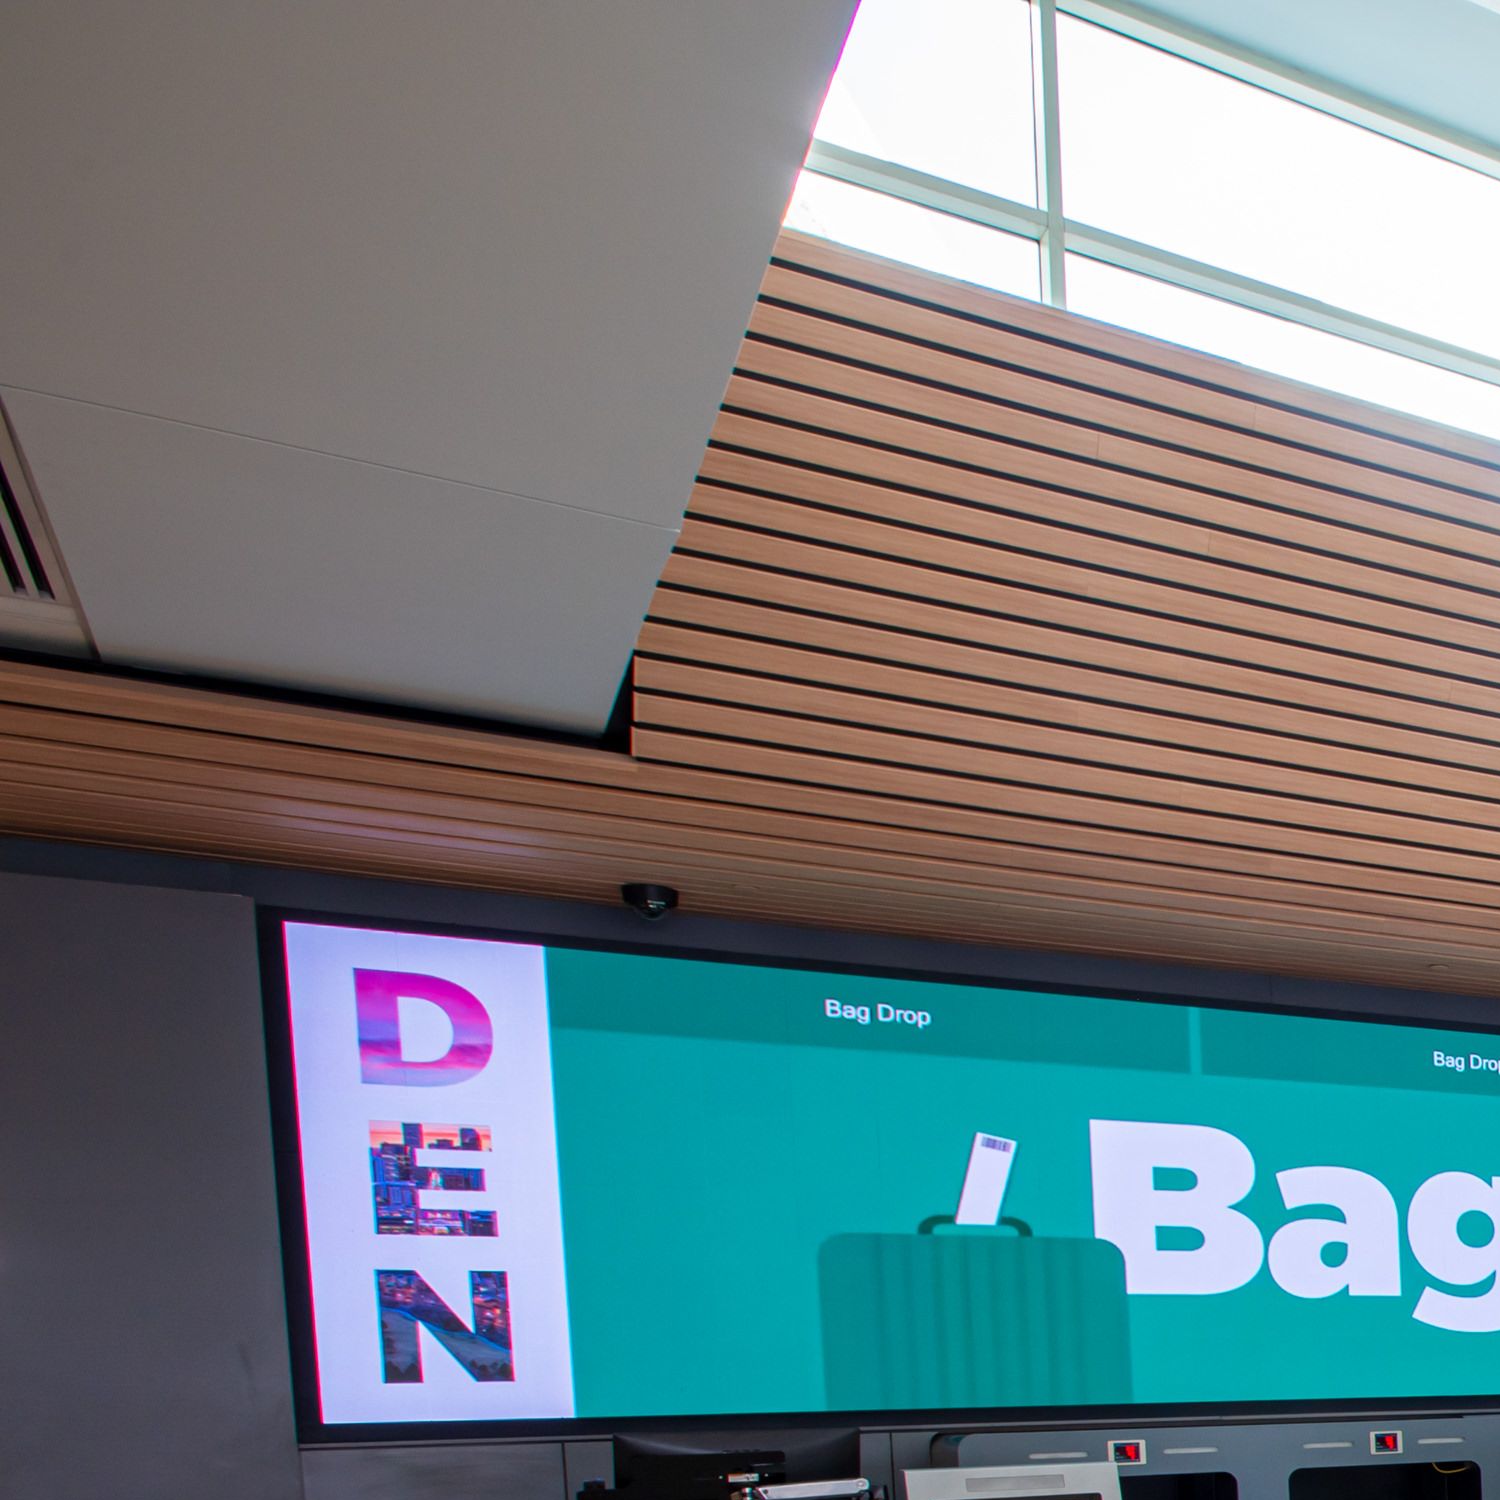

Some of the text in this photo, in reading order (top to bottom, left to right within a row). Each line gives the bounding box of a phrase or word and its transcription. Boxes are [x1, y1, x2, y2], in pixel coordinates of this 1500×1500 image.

[824, 998, 932, 1029] Bag Drop
[1433, 1050, 1465, 1073] Bag
[353, 967, 516, 1384] DEN
